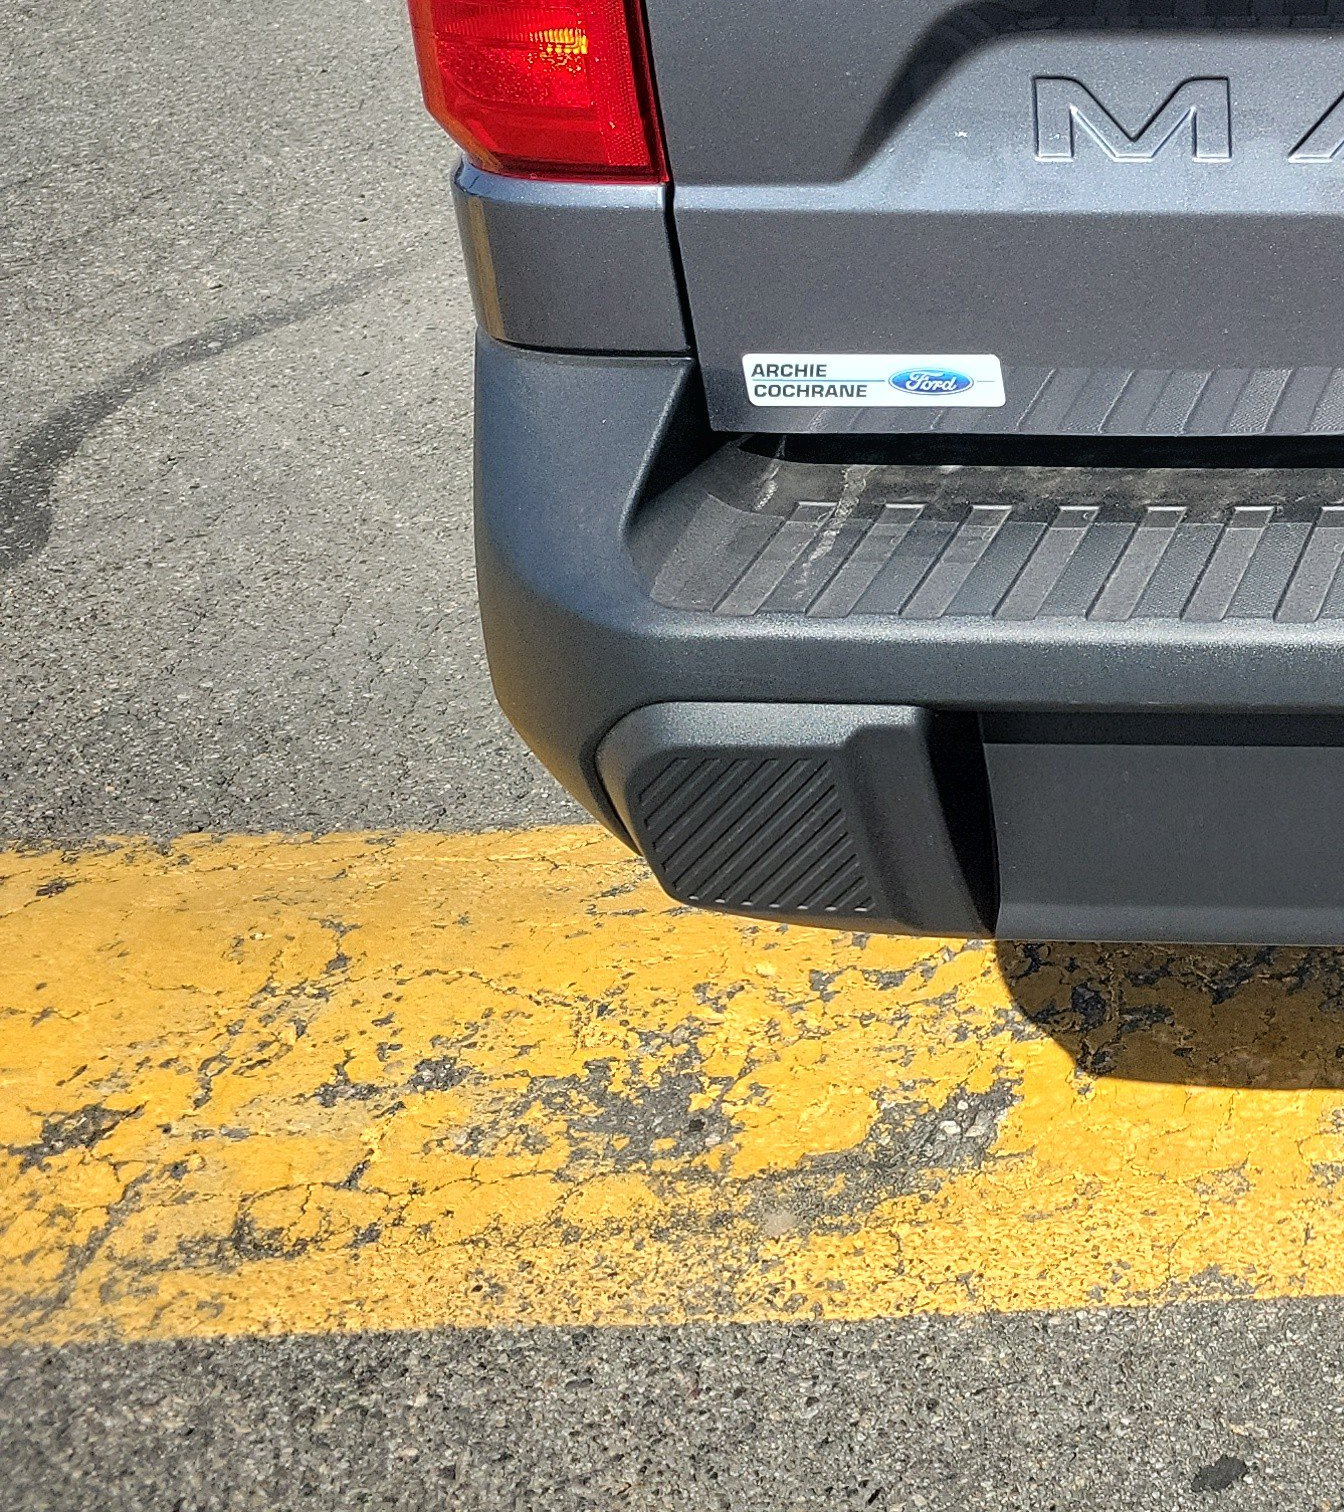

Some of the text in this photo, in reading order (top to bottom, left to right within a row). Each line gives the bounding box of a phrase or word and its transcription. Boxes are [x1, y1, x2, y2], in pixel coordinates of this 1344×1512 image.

[751, 363, 828, 378] ARCHIE
[905, 371, 959, 391] Ford
[754, 384, 868, 398] COCHRANE
